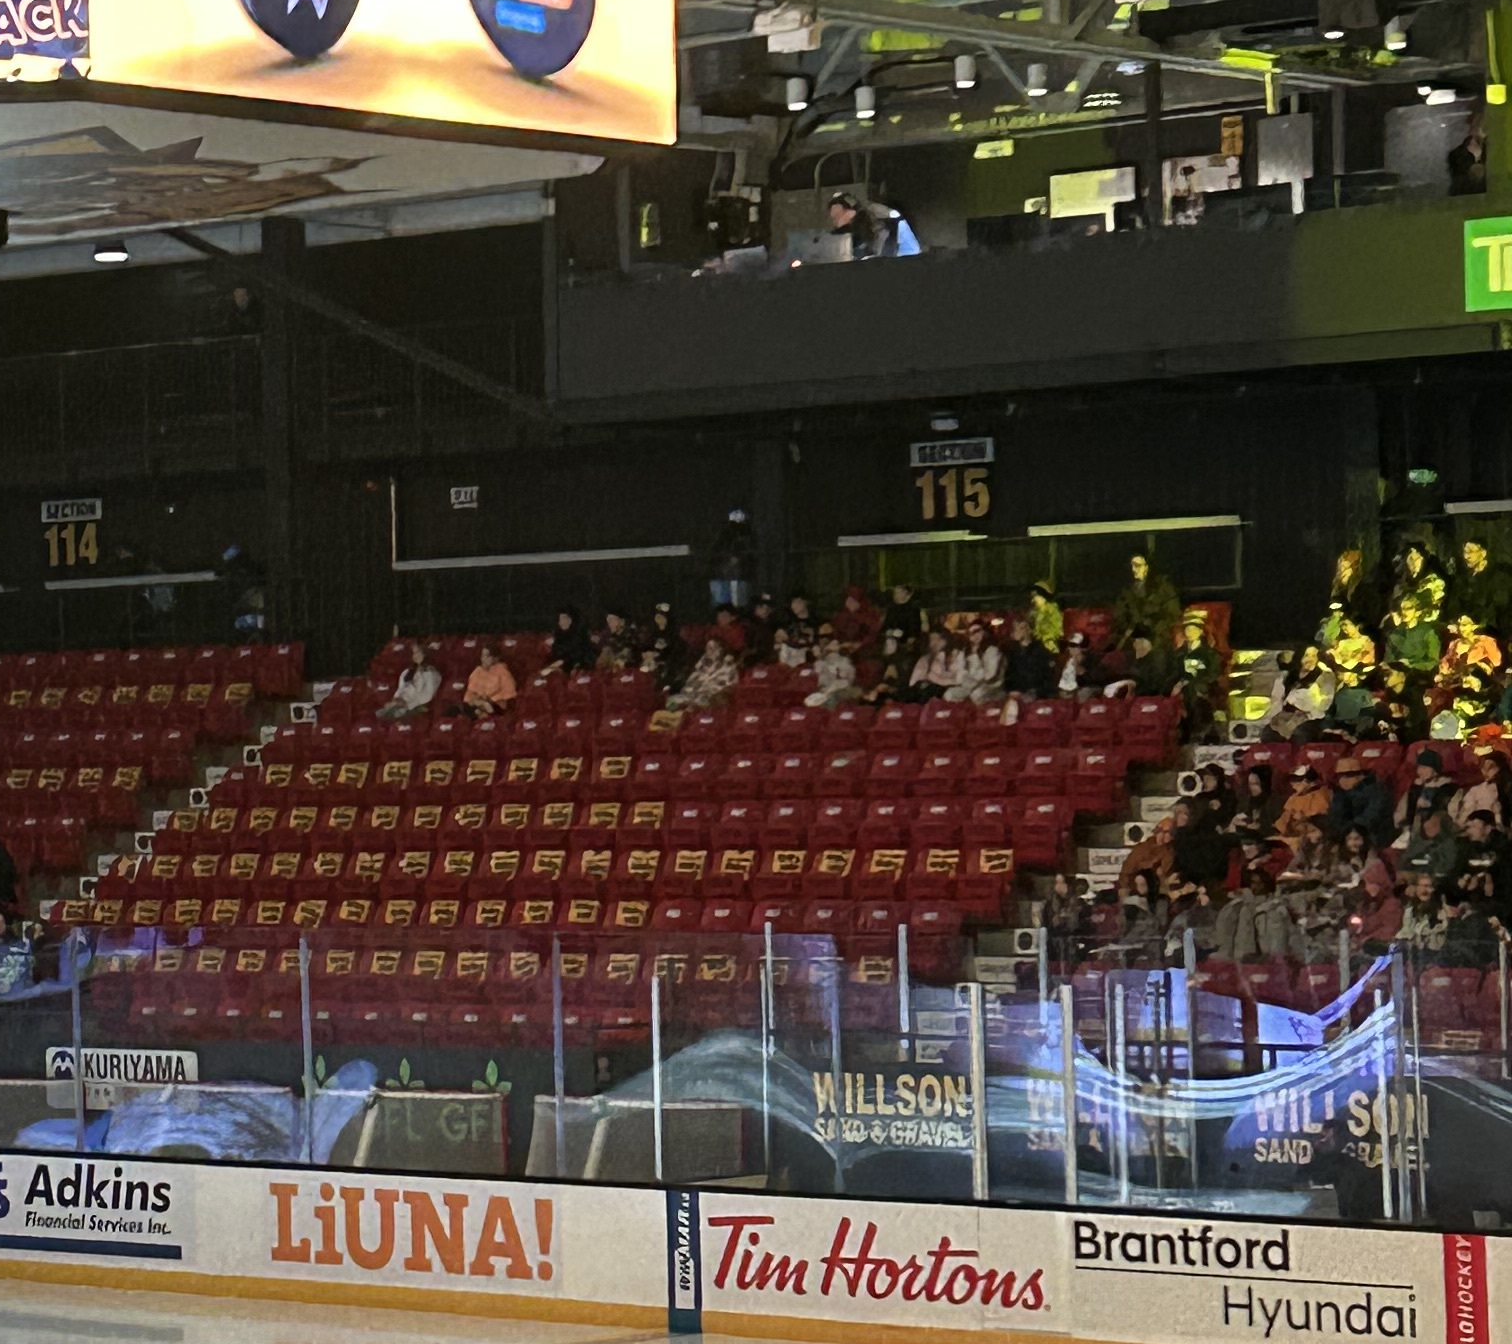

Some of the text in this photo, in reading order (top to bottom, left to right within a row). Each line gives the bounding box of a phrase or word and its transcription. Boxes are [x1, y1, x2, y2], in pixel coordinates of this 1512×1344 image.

[915, 467, 991, 520] 115
[43, 523, 99, 566] 114
[84, 1053, 187, 1082] KURIYAMA
[814, 1072, 975, 1117] WILLSON
[1254, 1137, 1313, 1166] SAND
[24, 1163, 172, 1213] Adkins
[25, 1210, 86, 1230] Financial
[88, 1214, 144, 1233] Services
[269, 1181, 554, 1282] LiUNA!
[1074, 1219, 1290, 1273] Brantford
[707, 1215, 808, 1296] Tim
[820, 1216, 1047, 1312] Hortons
[1223, 1284, 1418, 1340] Hyundai
